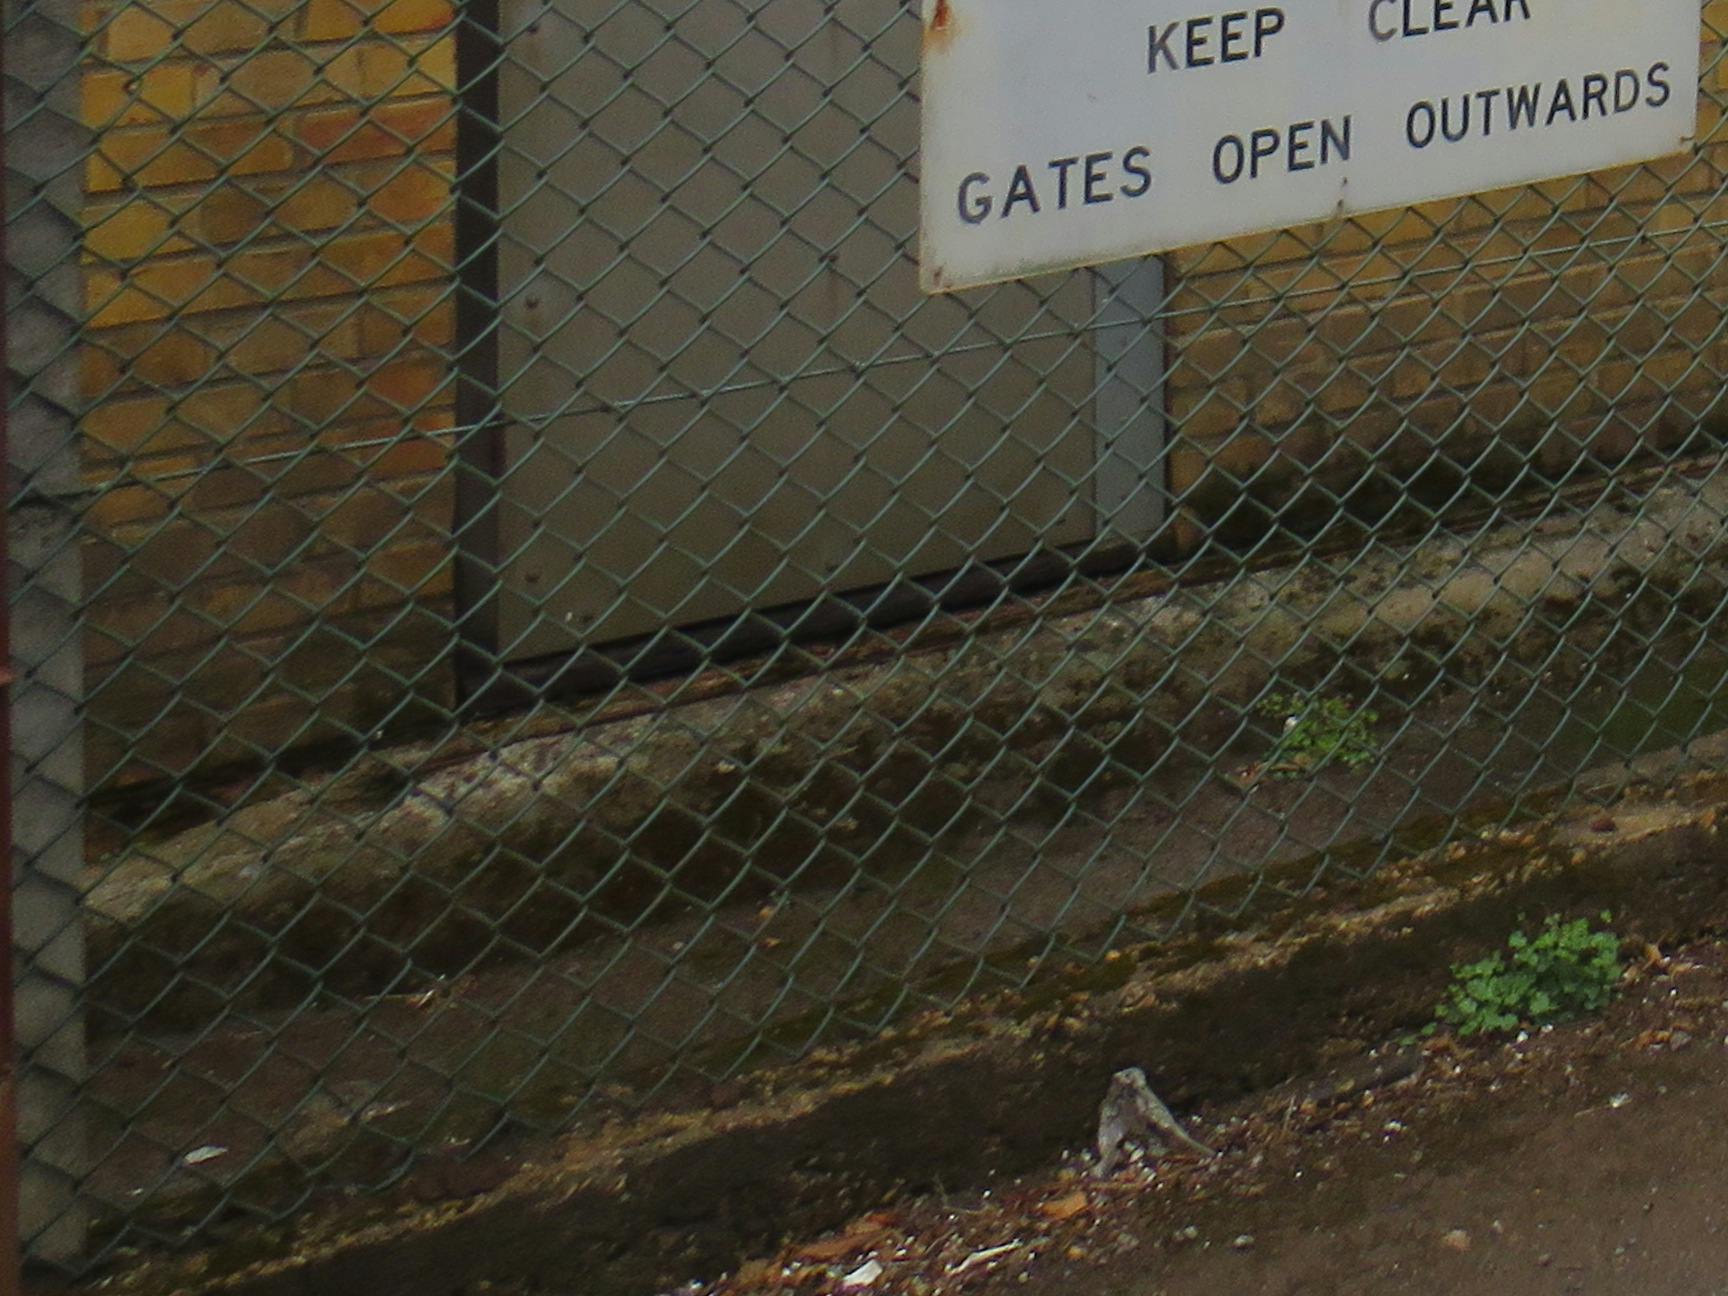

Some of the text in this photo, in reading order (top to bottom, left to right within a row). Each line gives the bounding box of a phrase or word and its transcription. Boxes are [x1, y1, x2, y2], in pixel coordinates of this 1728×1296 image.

[1146, 7, 1287, 75] KEEP
[957, 61, 1672, 226] GATES OPEN OUTWARDS
